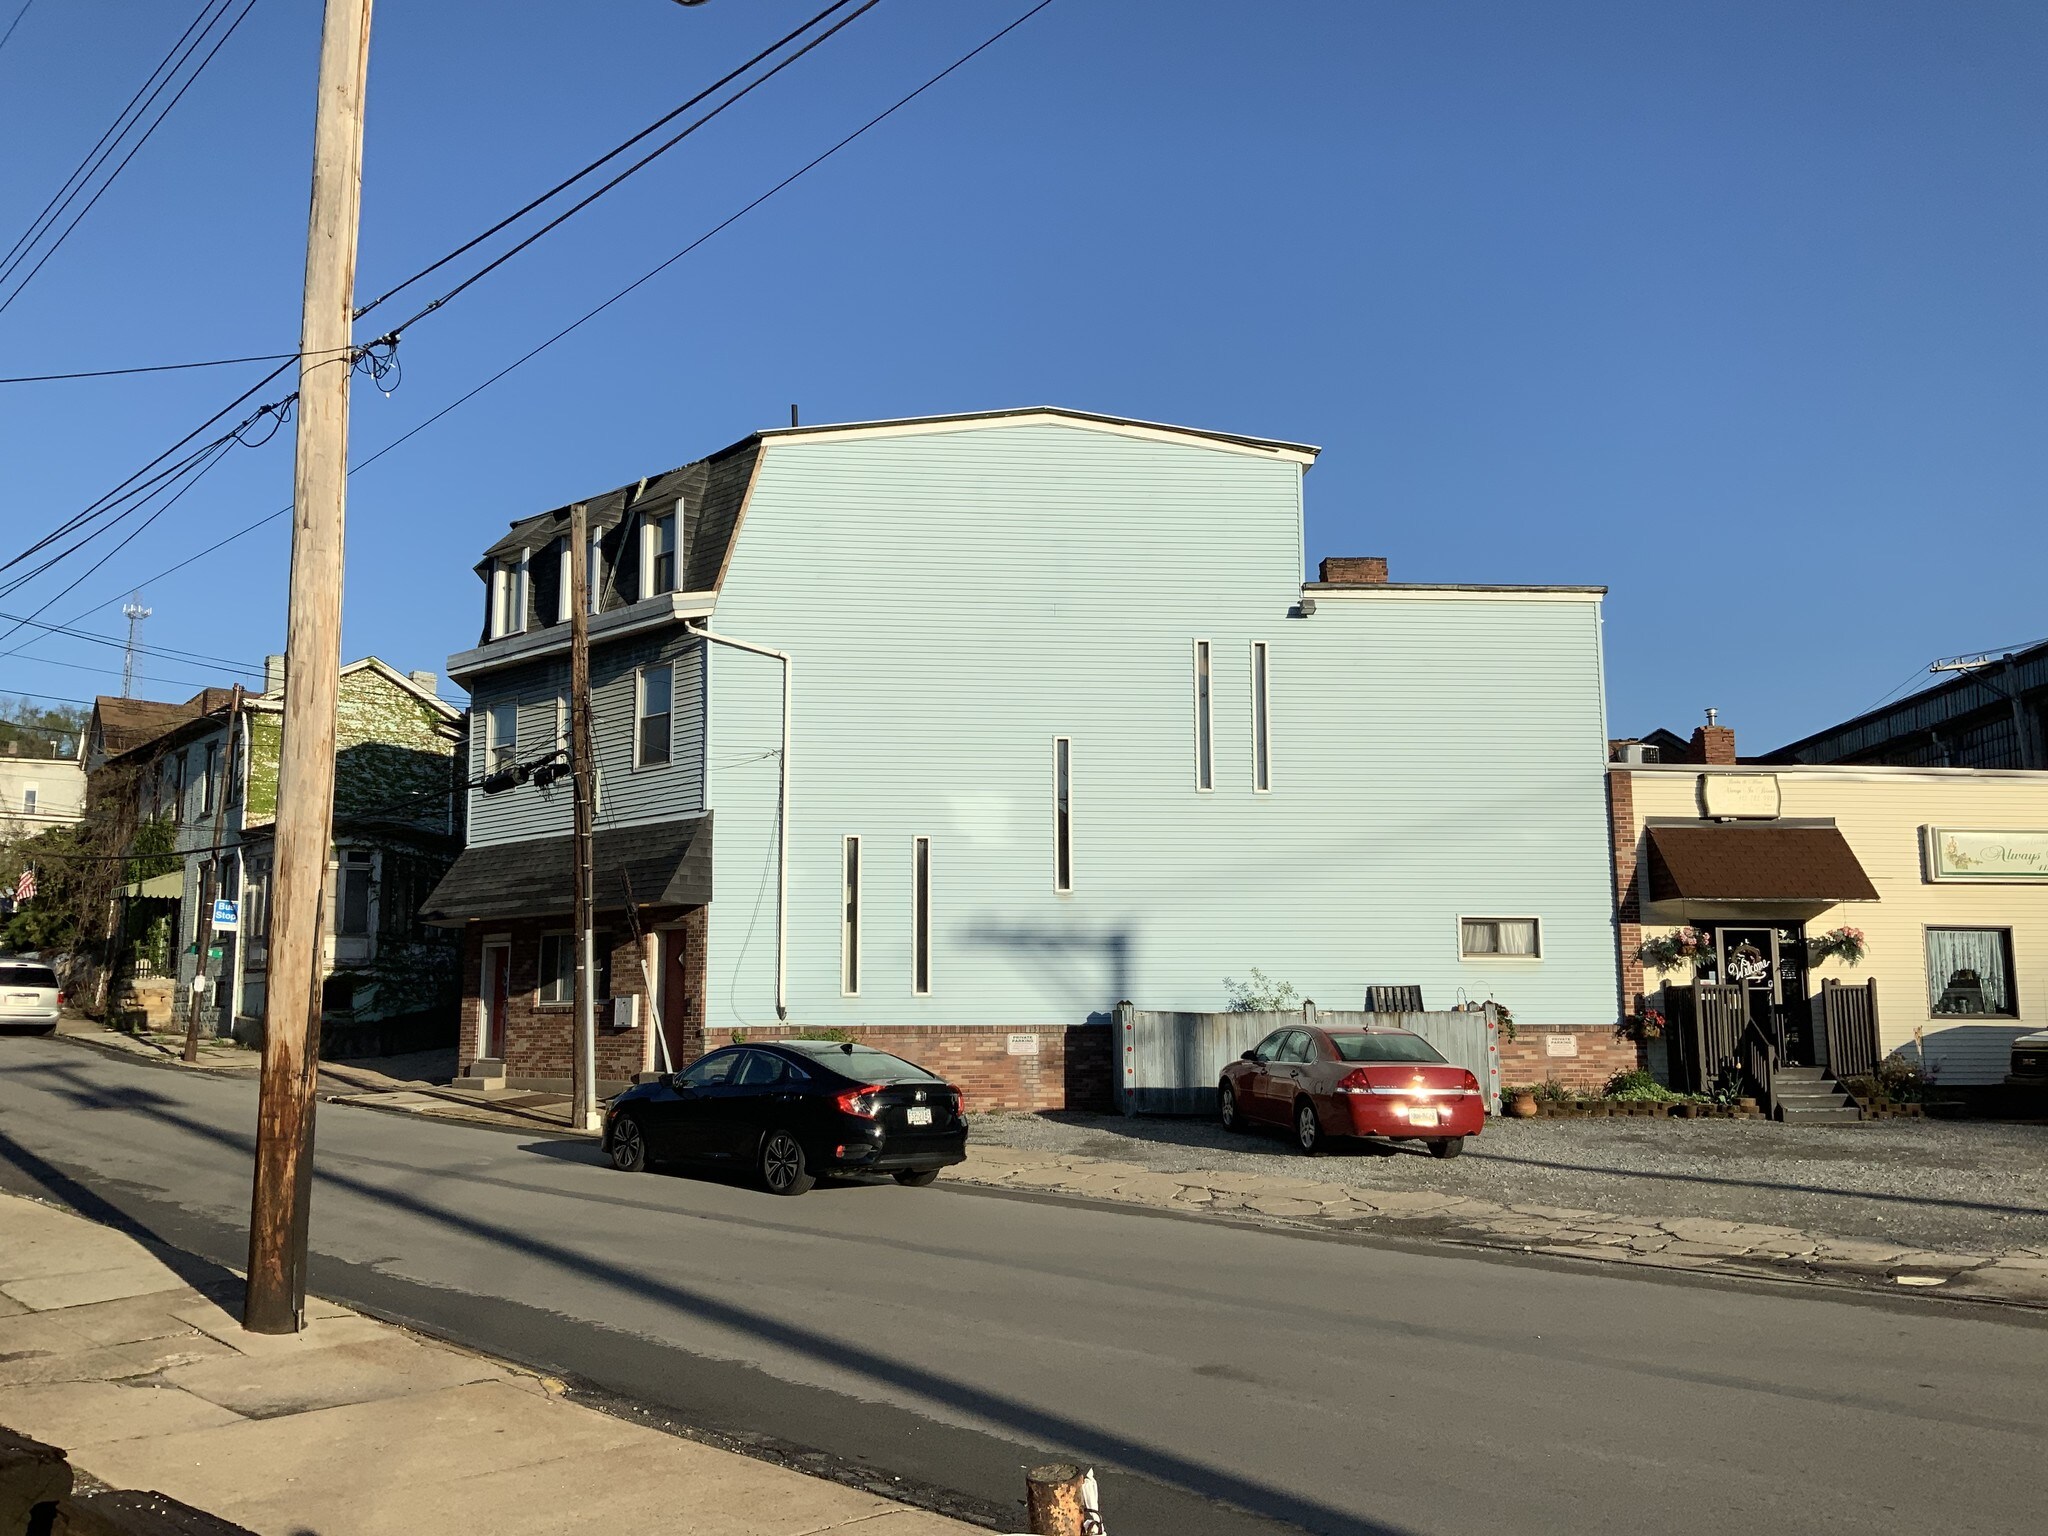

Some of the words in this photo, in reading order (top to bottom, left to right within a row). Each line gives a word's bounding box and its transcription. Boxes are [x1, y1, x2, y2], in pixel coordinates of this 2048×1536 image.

[1980, 845, 2040, 864] Always
[215, 911, 236, 921] Stop
[1728, 957, 1771, 981] Welcome
